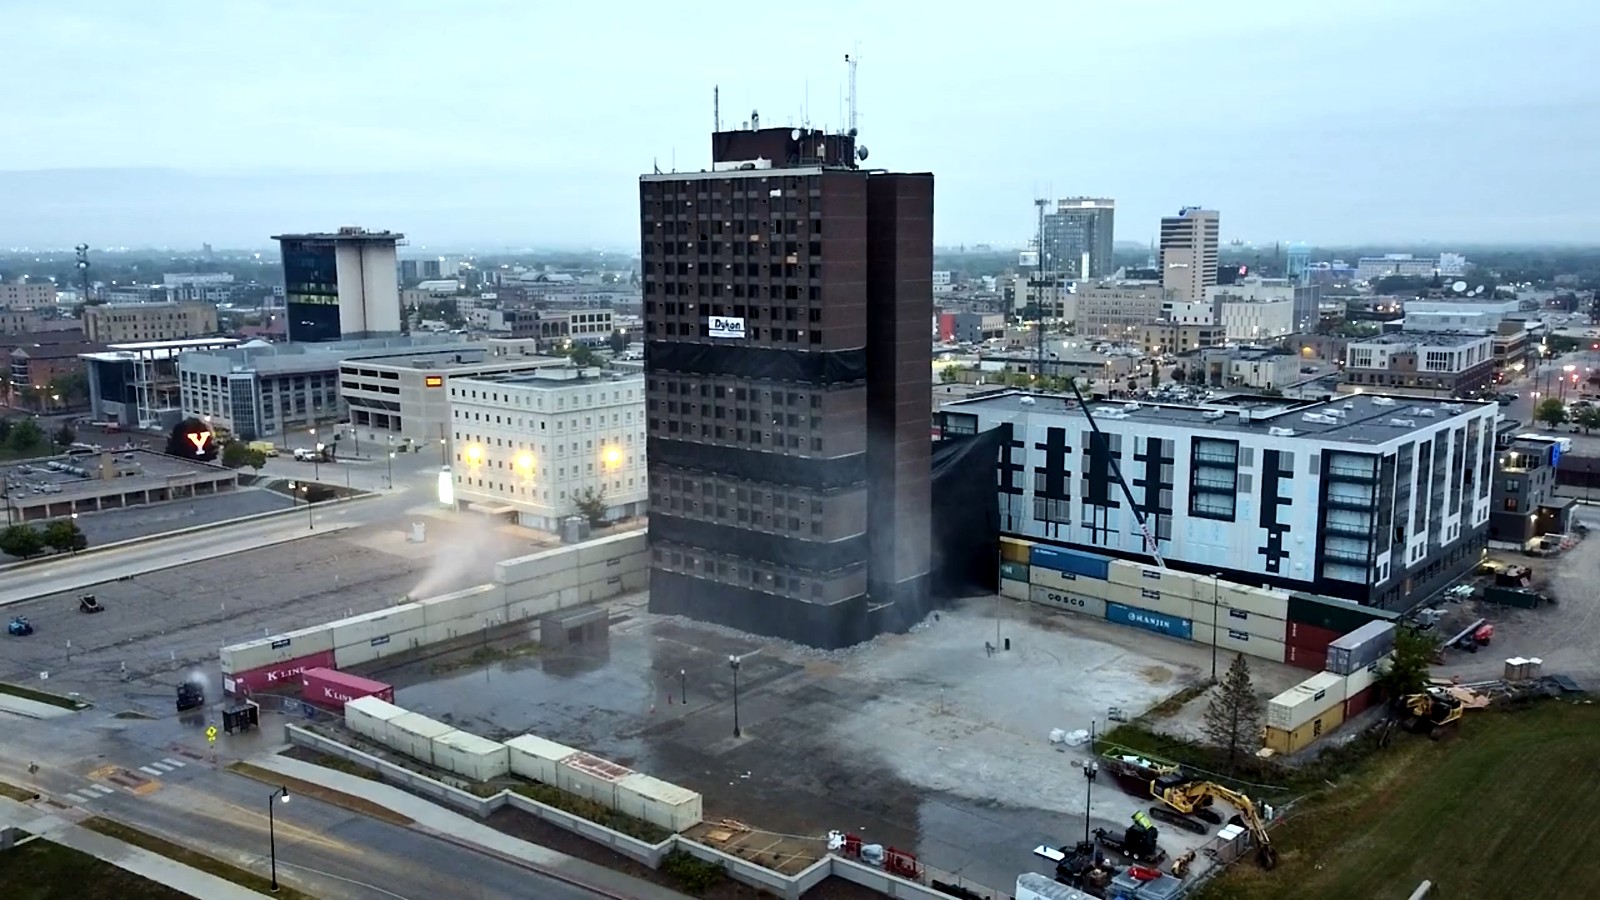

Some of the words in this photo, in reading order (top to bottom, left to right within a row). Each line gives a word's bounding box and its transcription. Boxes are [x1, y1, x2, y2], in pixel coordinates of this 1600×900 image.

[715, 318, 741, 330] Dykon
[187, 431, 211, 455] Y
[1047, 593, 1085, 607] COSCO
[1136, 615, 1170, 628] HANJIN
